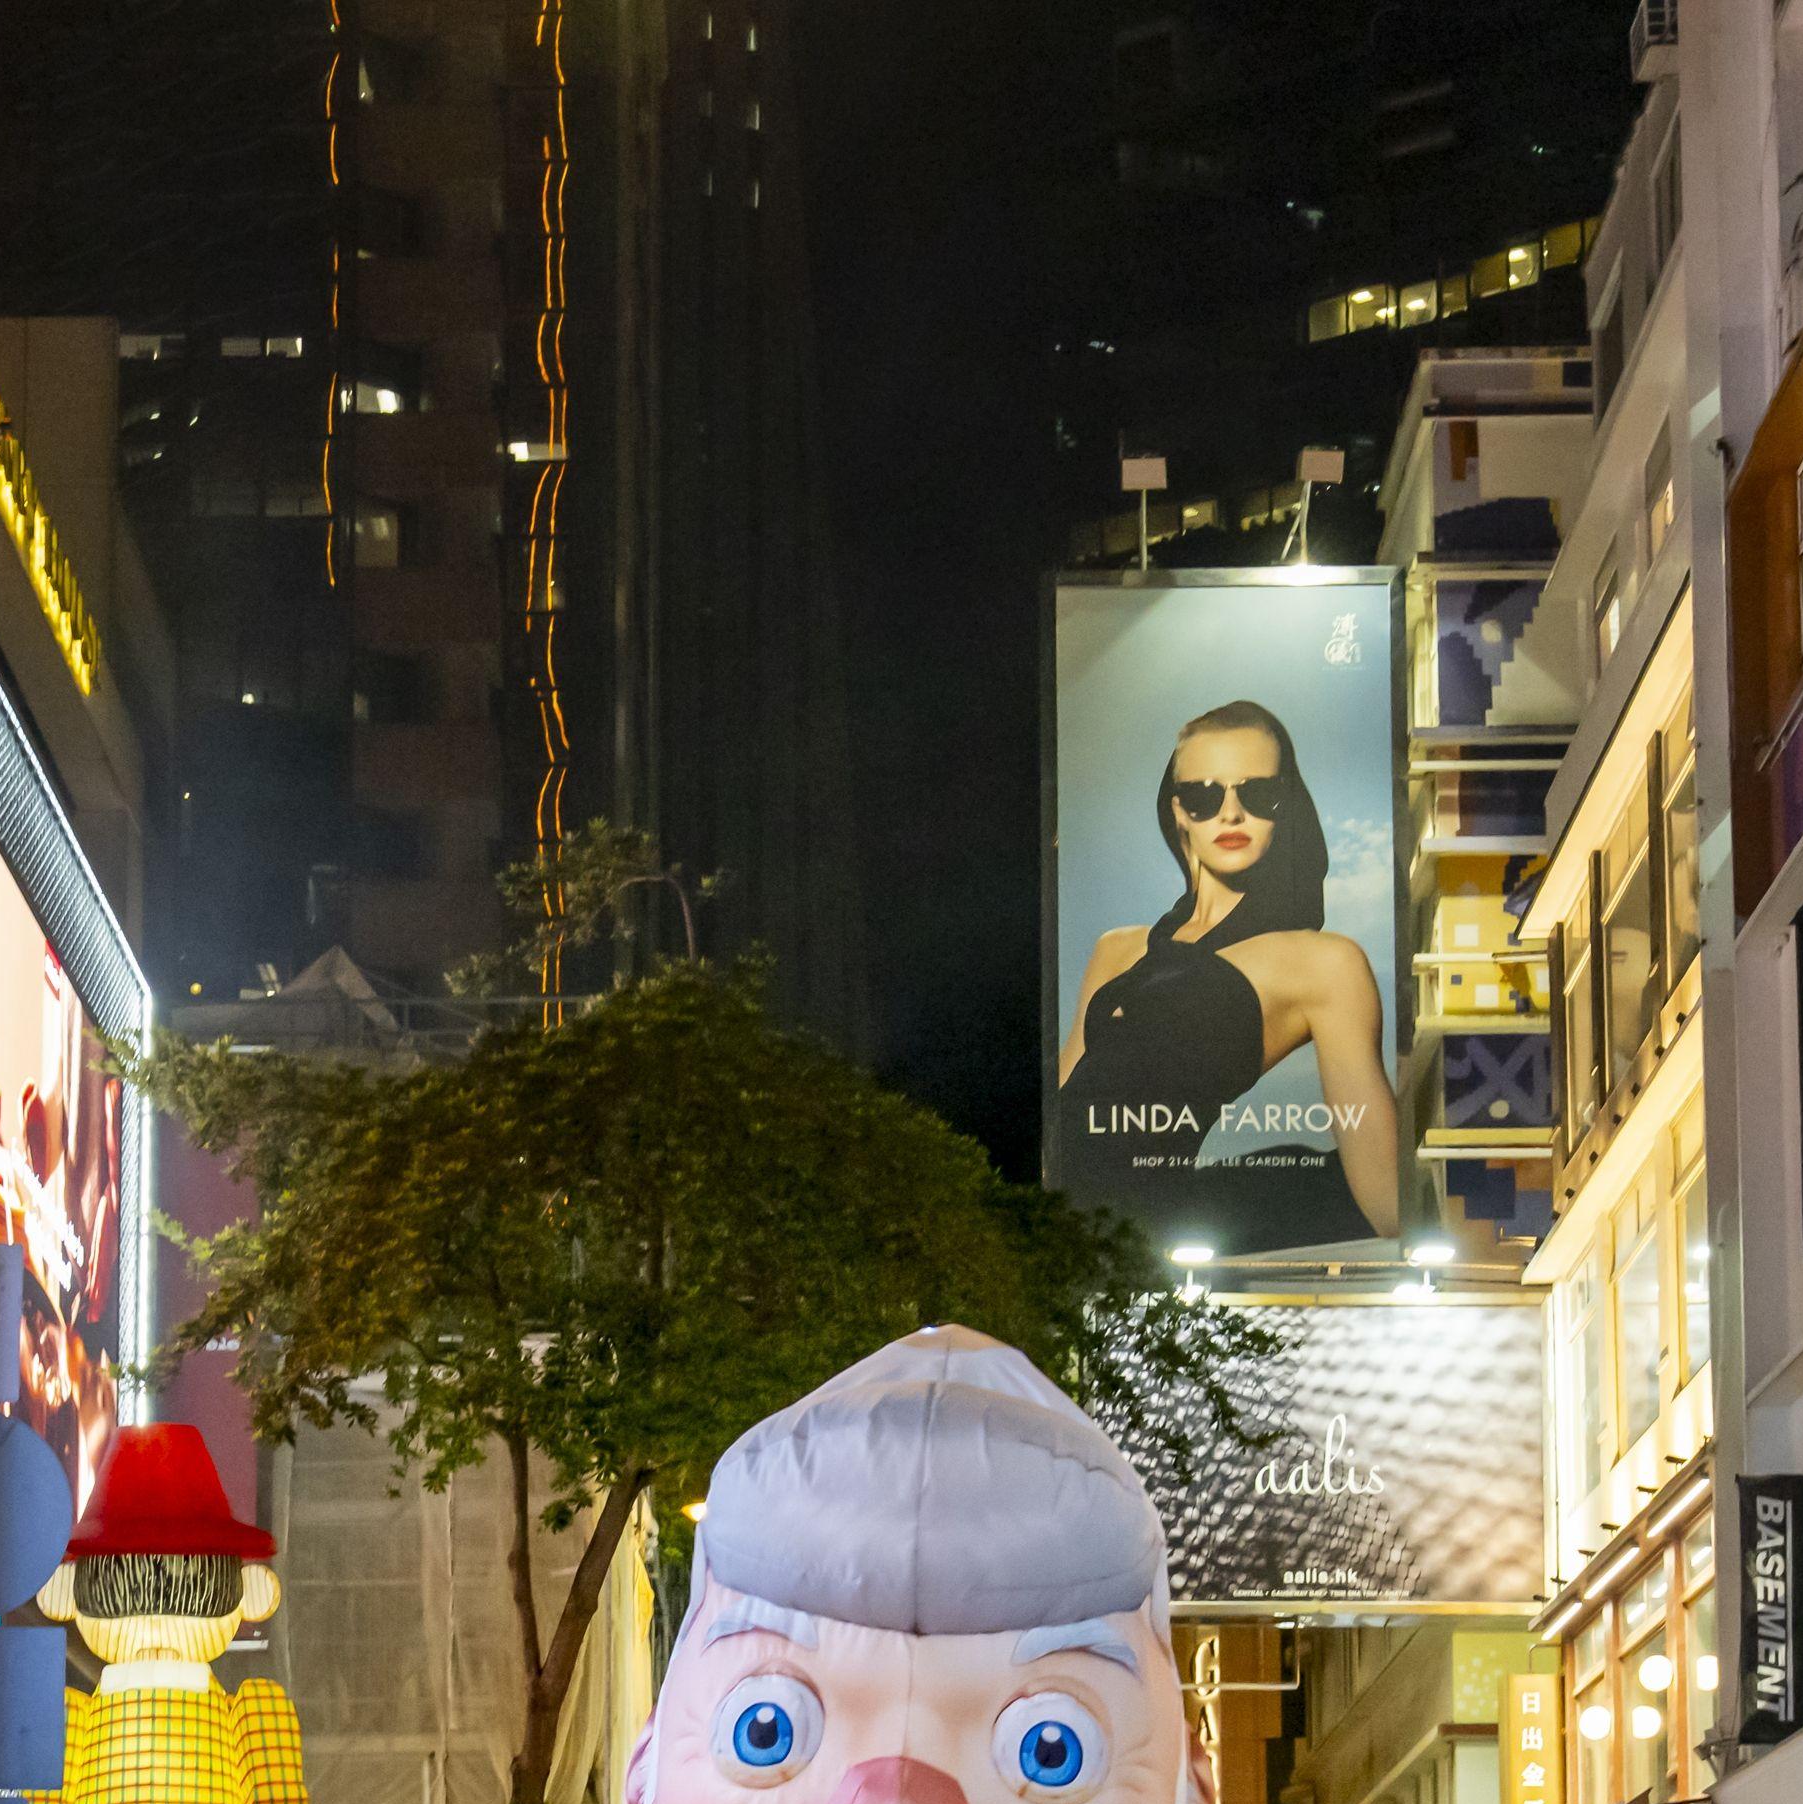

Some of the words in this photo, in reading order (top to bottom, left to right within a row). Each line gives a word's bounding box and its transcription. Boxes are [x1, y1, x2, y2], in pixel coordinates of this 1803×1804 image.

[1088, 1103, 1200, 1134] LINDA
[1220, 1103, 1367, 1133] FARROW
[1132, 1156, 1164, 1168] SHOP
[1222, 1156, 1241, 1167] LEE
[1246, 1156, 1296, 1167] GARDEN
[1300, 1156, 1325, 1167] ONE
[1254, 1413, 1384, 1495] aalis
[1283, 1568, 1358, 1584] aalis.hk
[1755, 1495, 1787, 1723] BASEMENT
